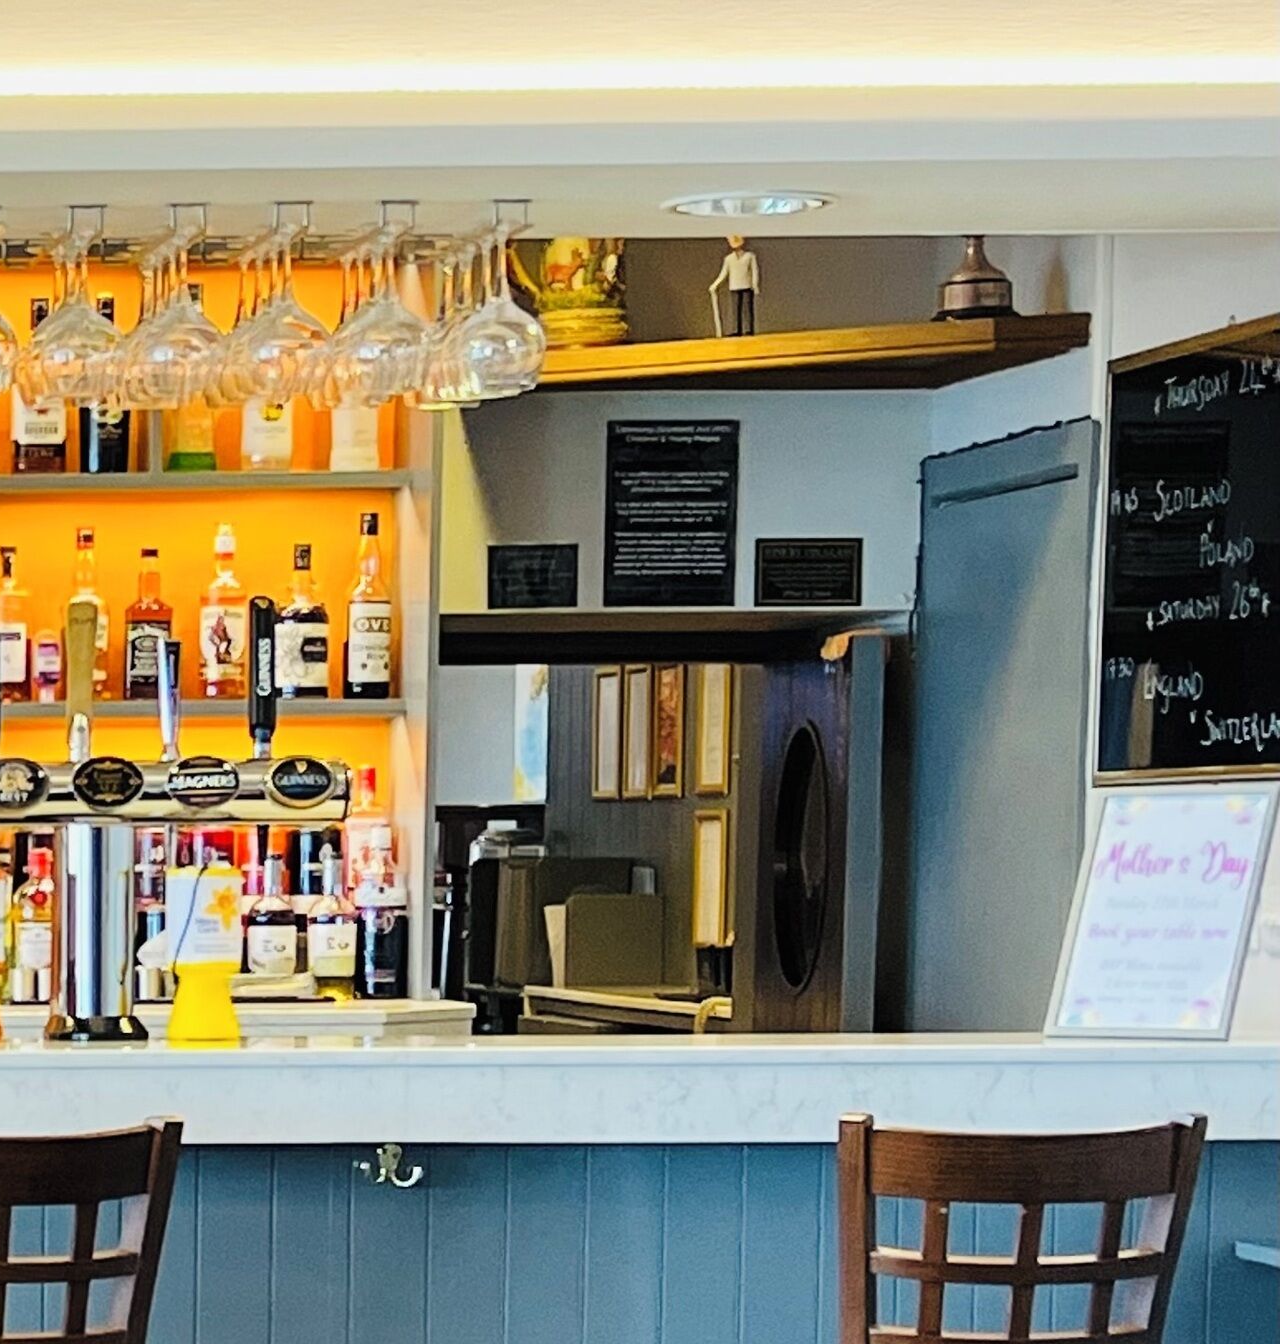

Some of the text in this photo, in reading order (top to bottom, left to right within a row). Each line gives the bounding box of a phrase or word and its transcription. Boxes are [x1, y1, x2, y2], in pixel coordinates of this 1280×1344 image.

[1153, 479, 1231, 522] SCOTLAND
[1199, 532, 1255, 568] POLAND
[1144, 658, 1204, 714] ENGLAND
[1200, 709, 1280, 752] SWITZERLA
[170, 773, 237, 791] MAGNERS
[275, 772, 328, 787] GUINNESS
[1202, 841, 1248, 889] Day
